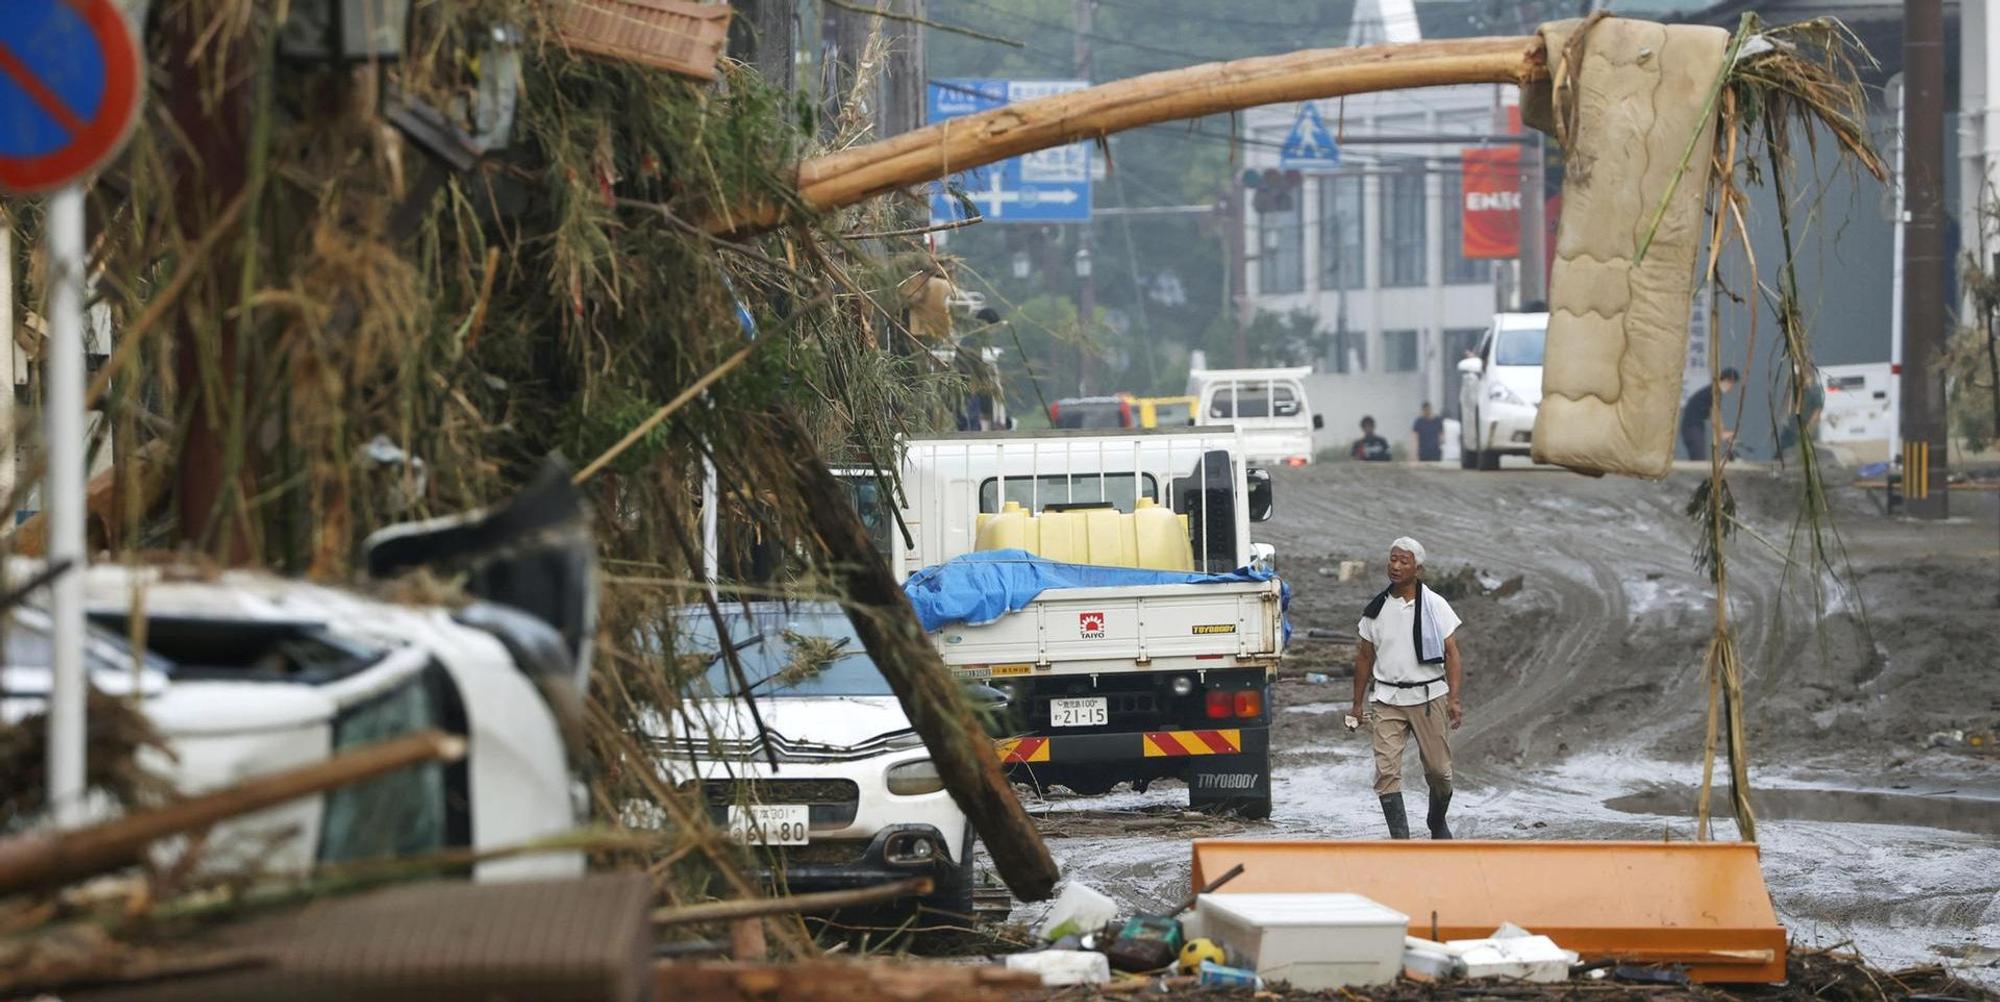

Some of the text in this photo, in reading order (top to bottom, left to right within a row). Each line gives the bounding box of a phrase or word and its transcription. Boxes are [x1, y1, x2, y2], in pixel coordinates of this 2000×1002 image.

[1081, 631, 1105, 639] TAIYO
[1063, 708, 1105, 723] 21-15
[1198, 773, 1258, 788] TOYOBODY
